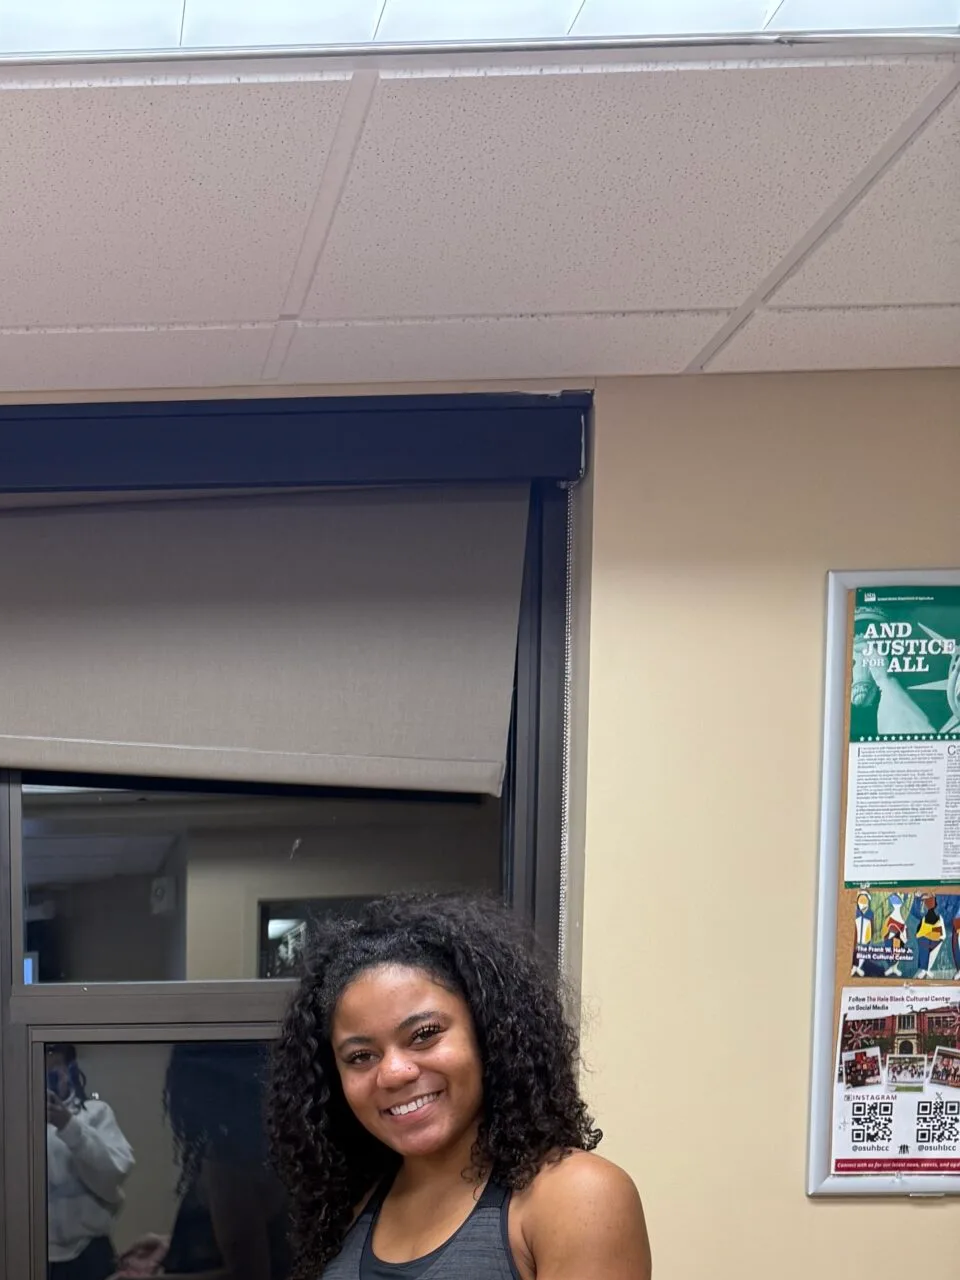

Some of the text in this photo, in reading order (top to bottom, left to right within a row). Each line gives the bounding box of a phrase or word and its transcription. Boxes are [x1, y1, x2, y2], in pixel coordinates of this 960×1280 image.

[863, 622, 912, 639] AND
[862, 639, 956, 656] JUSTICE
[862, 657, 929, 672] FOR ALL
